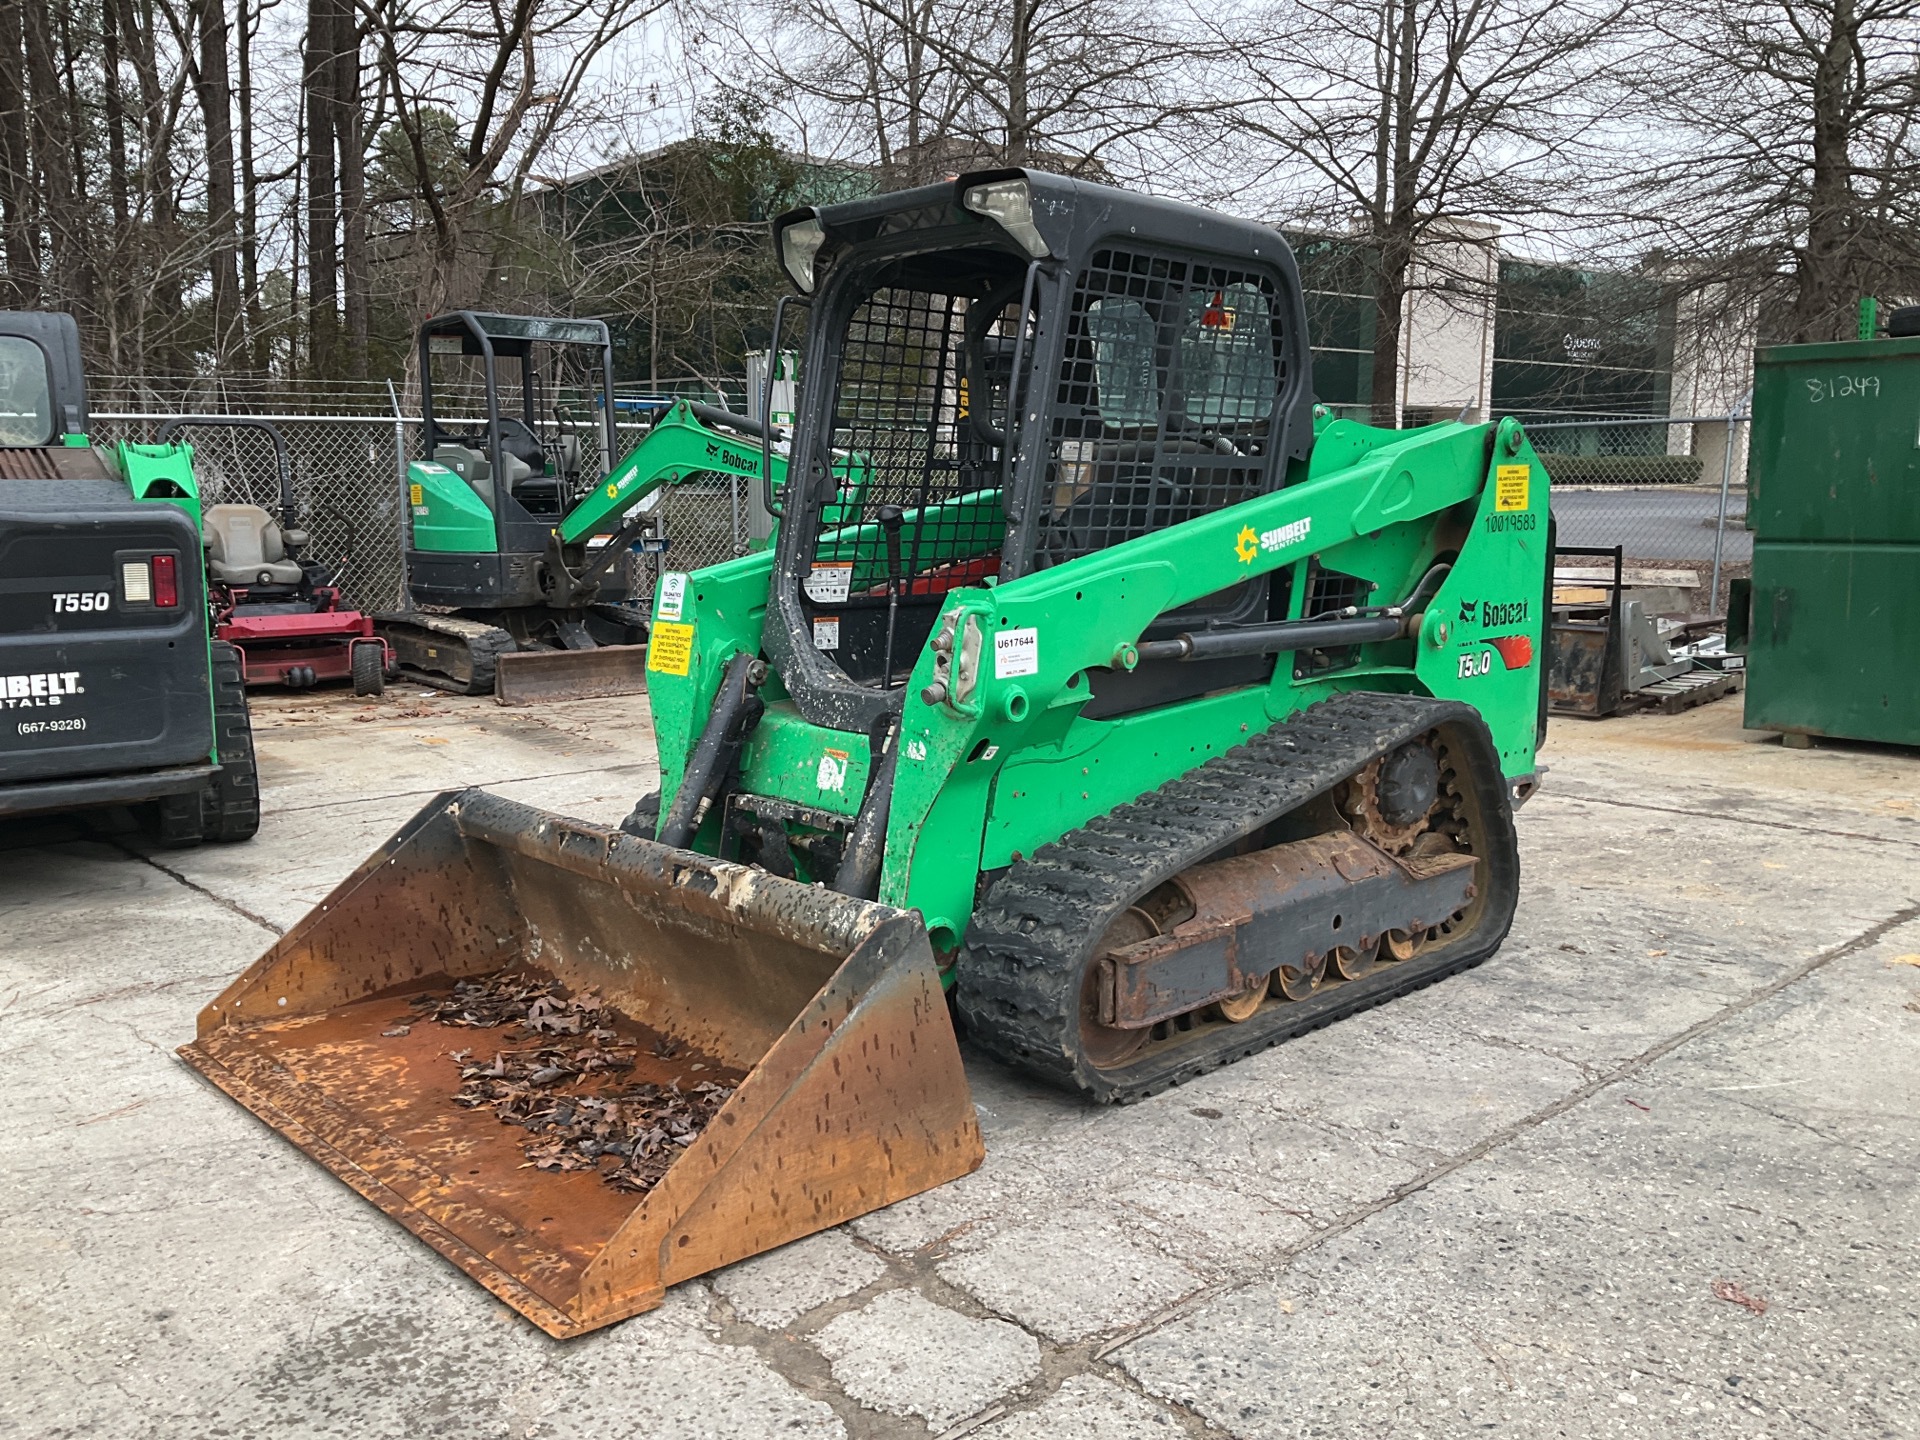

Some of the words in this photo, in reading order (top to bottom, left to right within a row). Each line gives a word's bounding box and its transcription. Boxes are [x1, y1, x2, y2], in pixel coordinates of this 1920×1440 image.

[958, 377, 969, 419] Yale
[722, 449, 758, 475] Bobcat
[1261, 516, 1311, 549] SUNBELT
[1485, 514, 1536, 533] 10019583
[1268, 534, 1306, 552] RENTALS
[53, 592, 110, 612] T550
[998, 636, 1034, 649] U617644
[17, 718, 87, 735] (667-9328)
